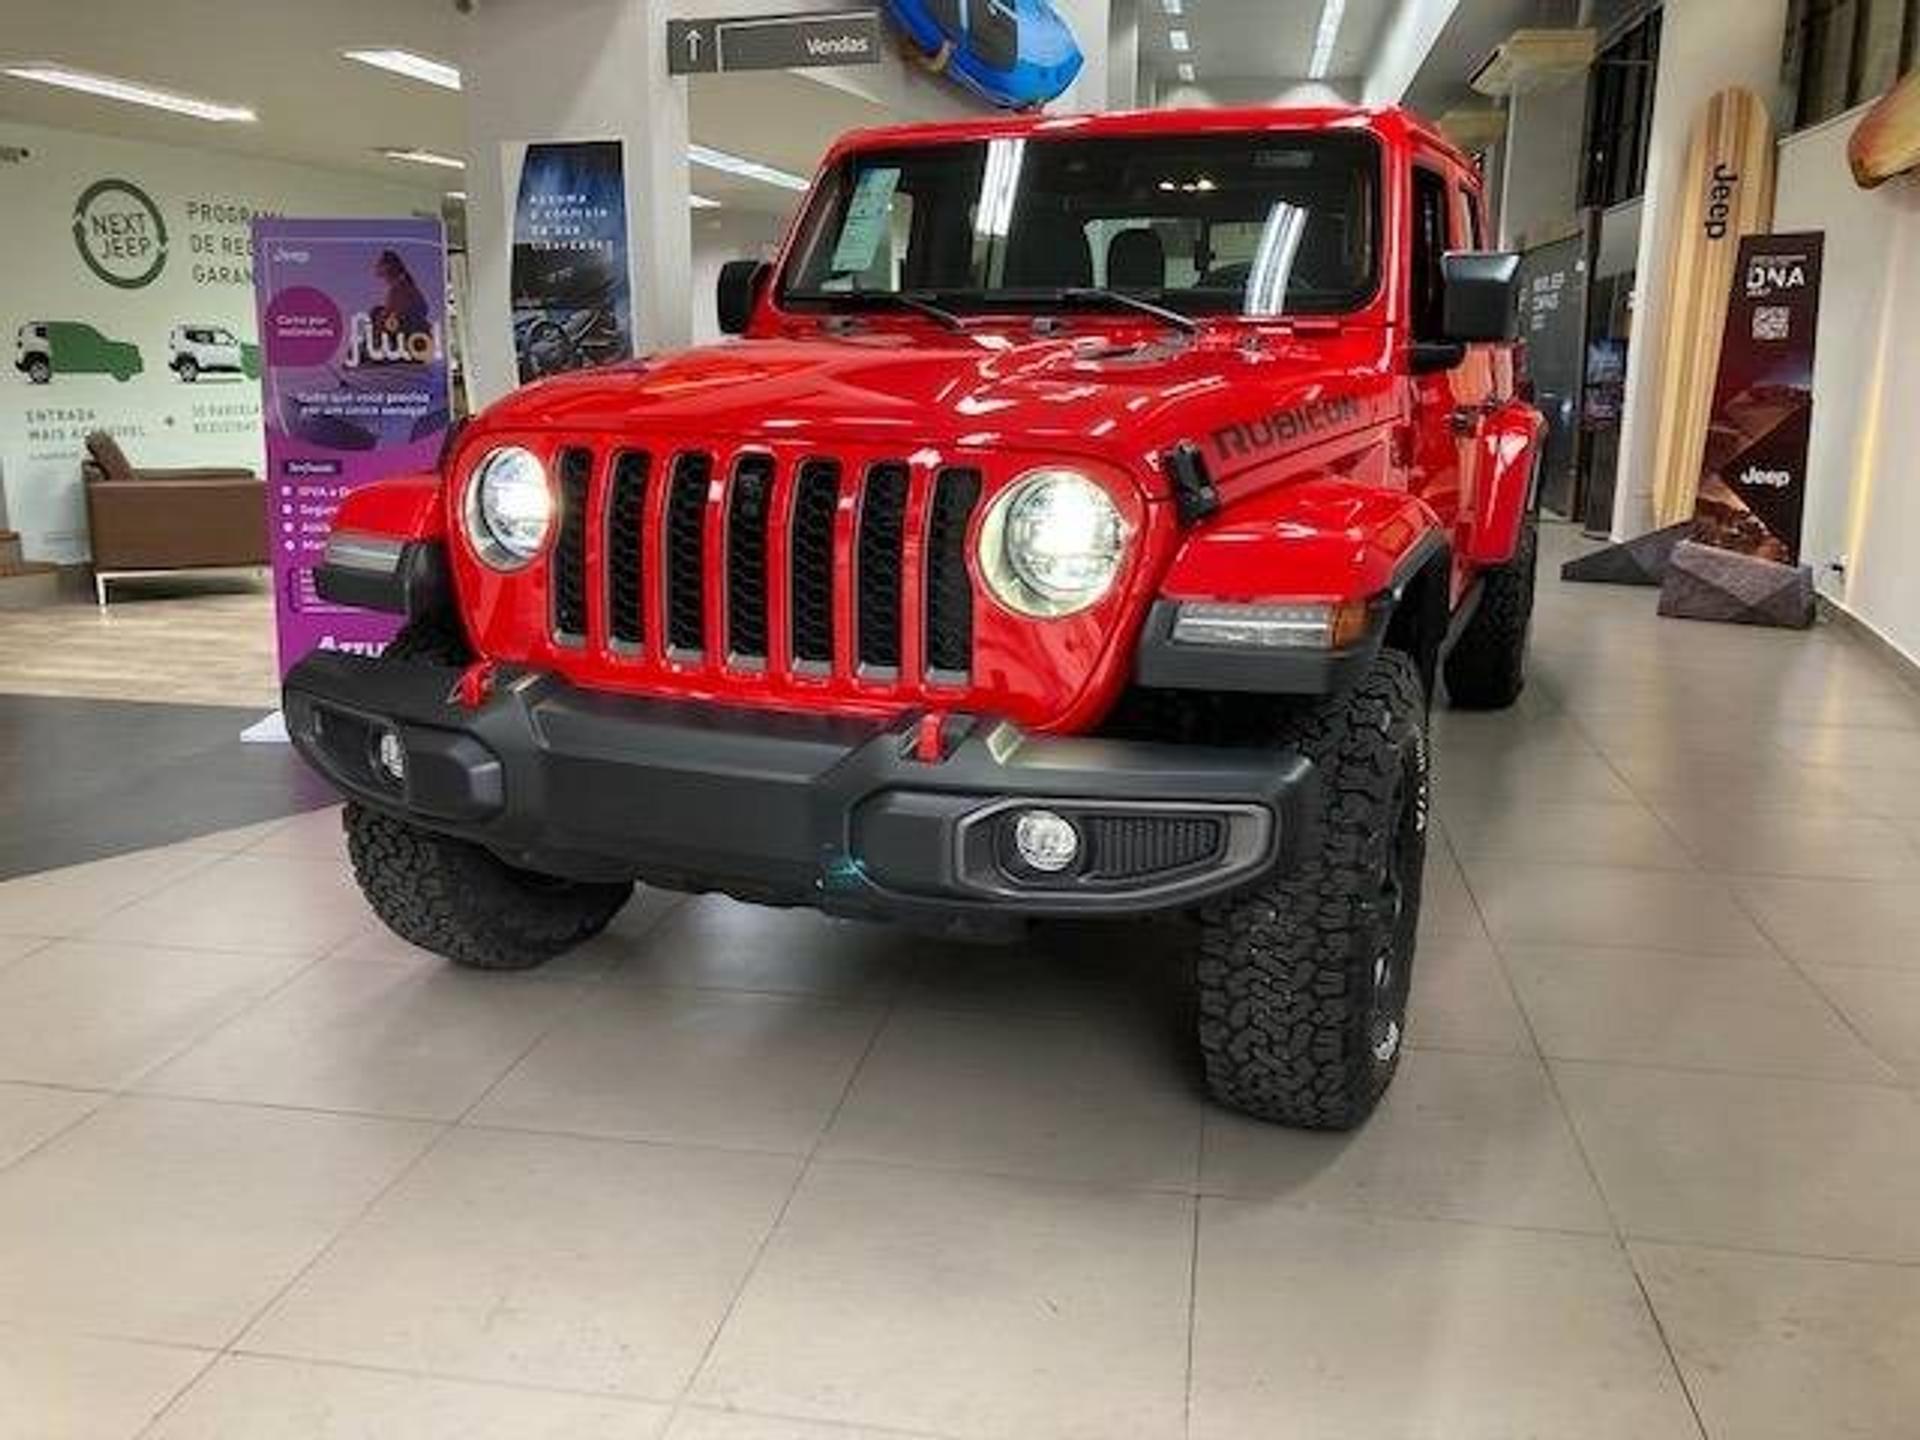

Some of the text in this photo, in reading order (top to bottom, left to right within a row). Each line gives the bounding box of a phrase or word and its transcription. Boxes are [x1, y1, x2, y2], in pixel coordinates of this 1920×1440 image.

[806, 36, 869, 56] Vendas
[1704, 163, 1738, 239] Jeep
[91, 211, 146, 237] NEXT
[101, 236, 151, 260] JEEP
[190, 234, 215, 254] DE
[1746, 266, 1806, 289] DNA
[1212, 394, 1360, 461] RUBICON
[1740, 466, 1791, 489] Jeep
